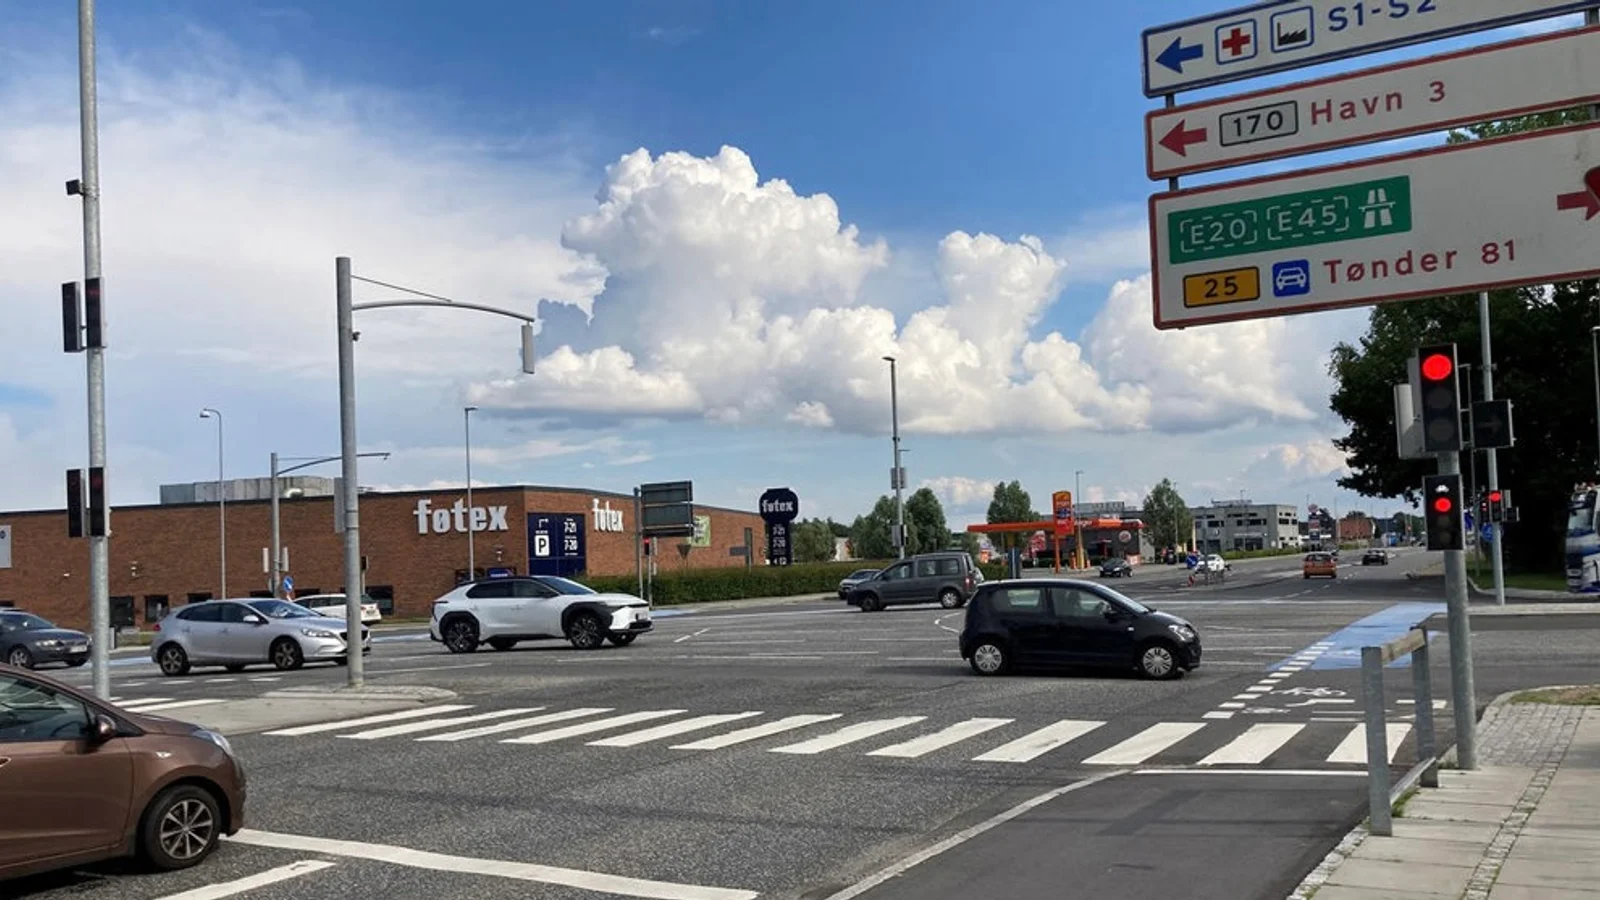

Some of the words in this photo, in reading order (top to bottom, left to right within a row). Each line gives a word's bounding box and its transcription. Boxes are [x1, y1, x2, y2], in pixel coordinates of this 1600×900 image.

[1234, 110, 1283, 137] 170
[1310, 91, 1403, 125] Havn
[1429, 81, 1446, 102] 3
[1191, 218, 1247, 245] E20
[1278, 204, 1338, 232] E45
[1204, 275, 1239, 298] 25
[1324, 250, 1458, 284] Tønder
[1481, 239, 1516, 265] 81
[413, 498, 509, 535] føtex
[538, 537, 547, 553] P
